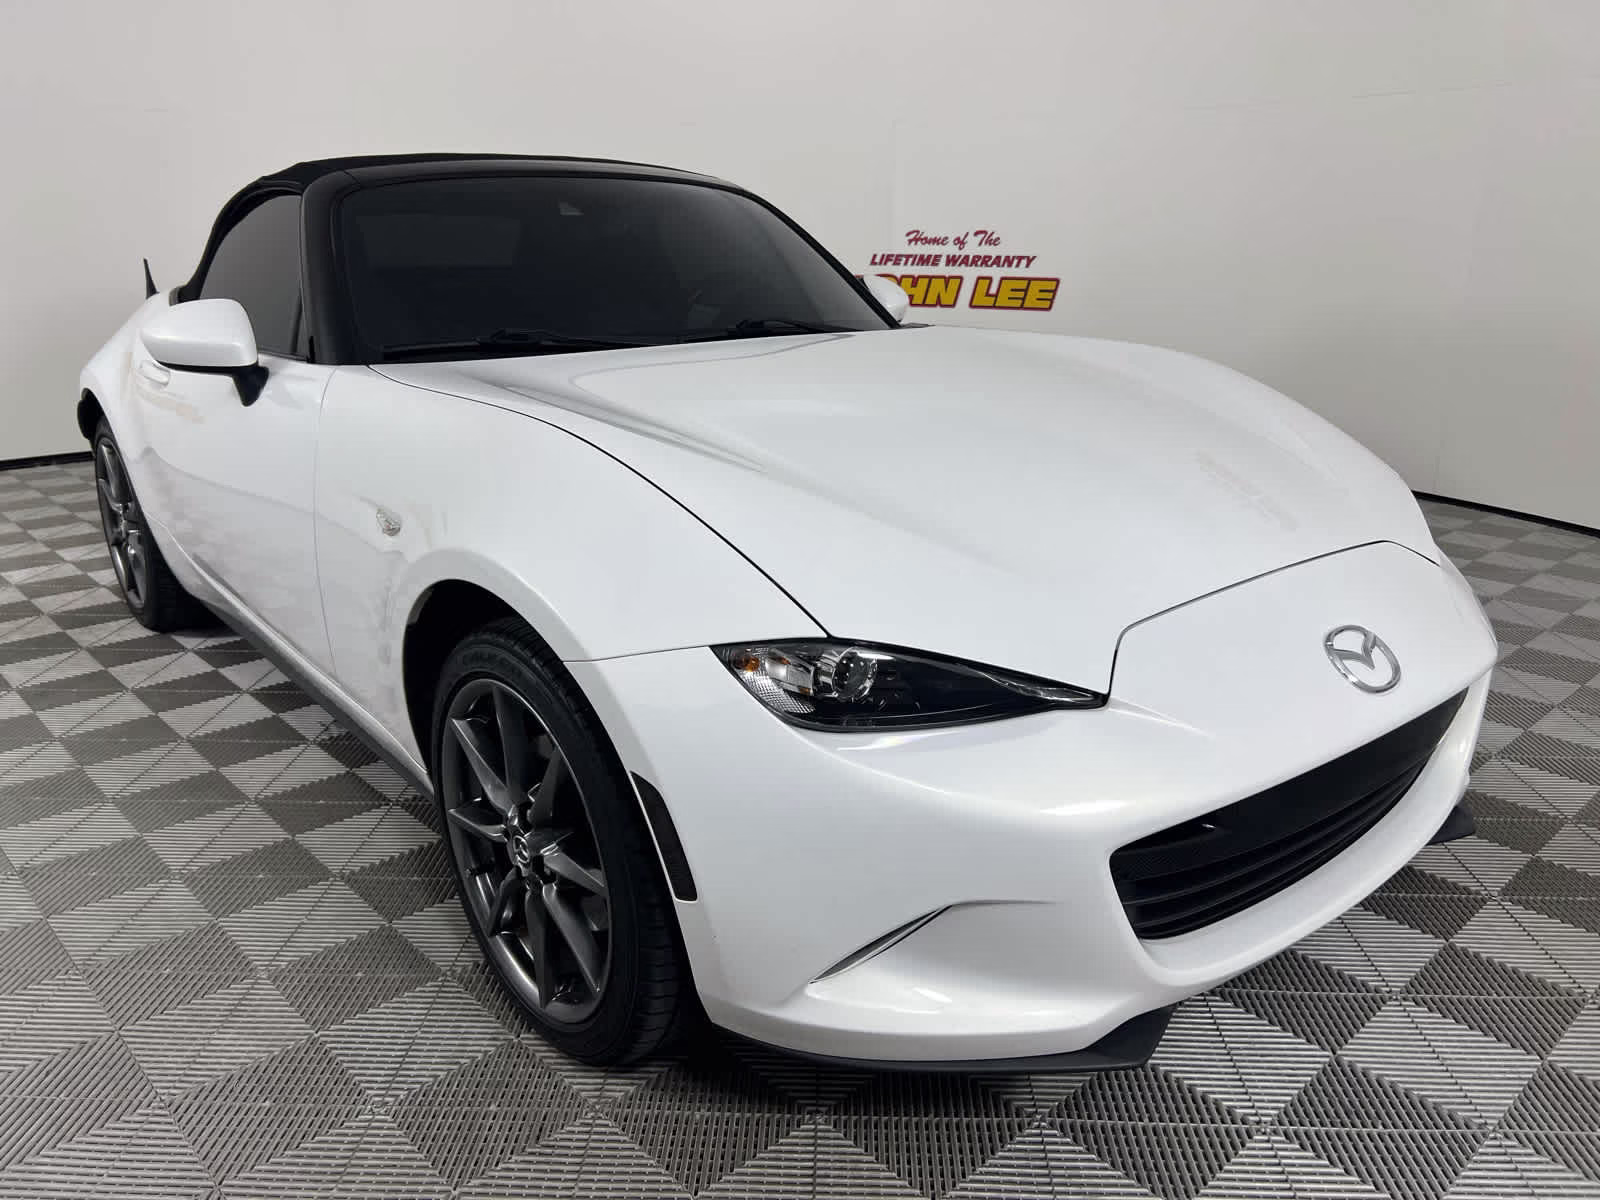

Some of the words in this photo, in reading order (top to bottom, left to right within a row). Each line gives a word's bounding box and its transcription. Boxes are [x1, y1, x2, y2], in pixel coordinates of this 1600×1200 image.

[905, 230, 948, 246] Home
[953, 232, 969, 250] of
[973, 230, 1001, 246] The
[870, 254, 942, 267] LIFETIME
[945, 255, 1036, 268] WARRANTY
[862, 274, 963, 307] HN
[969, 276, 1060, 311] LEE
